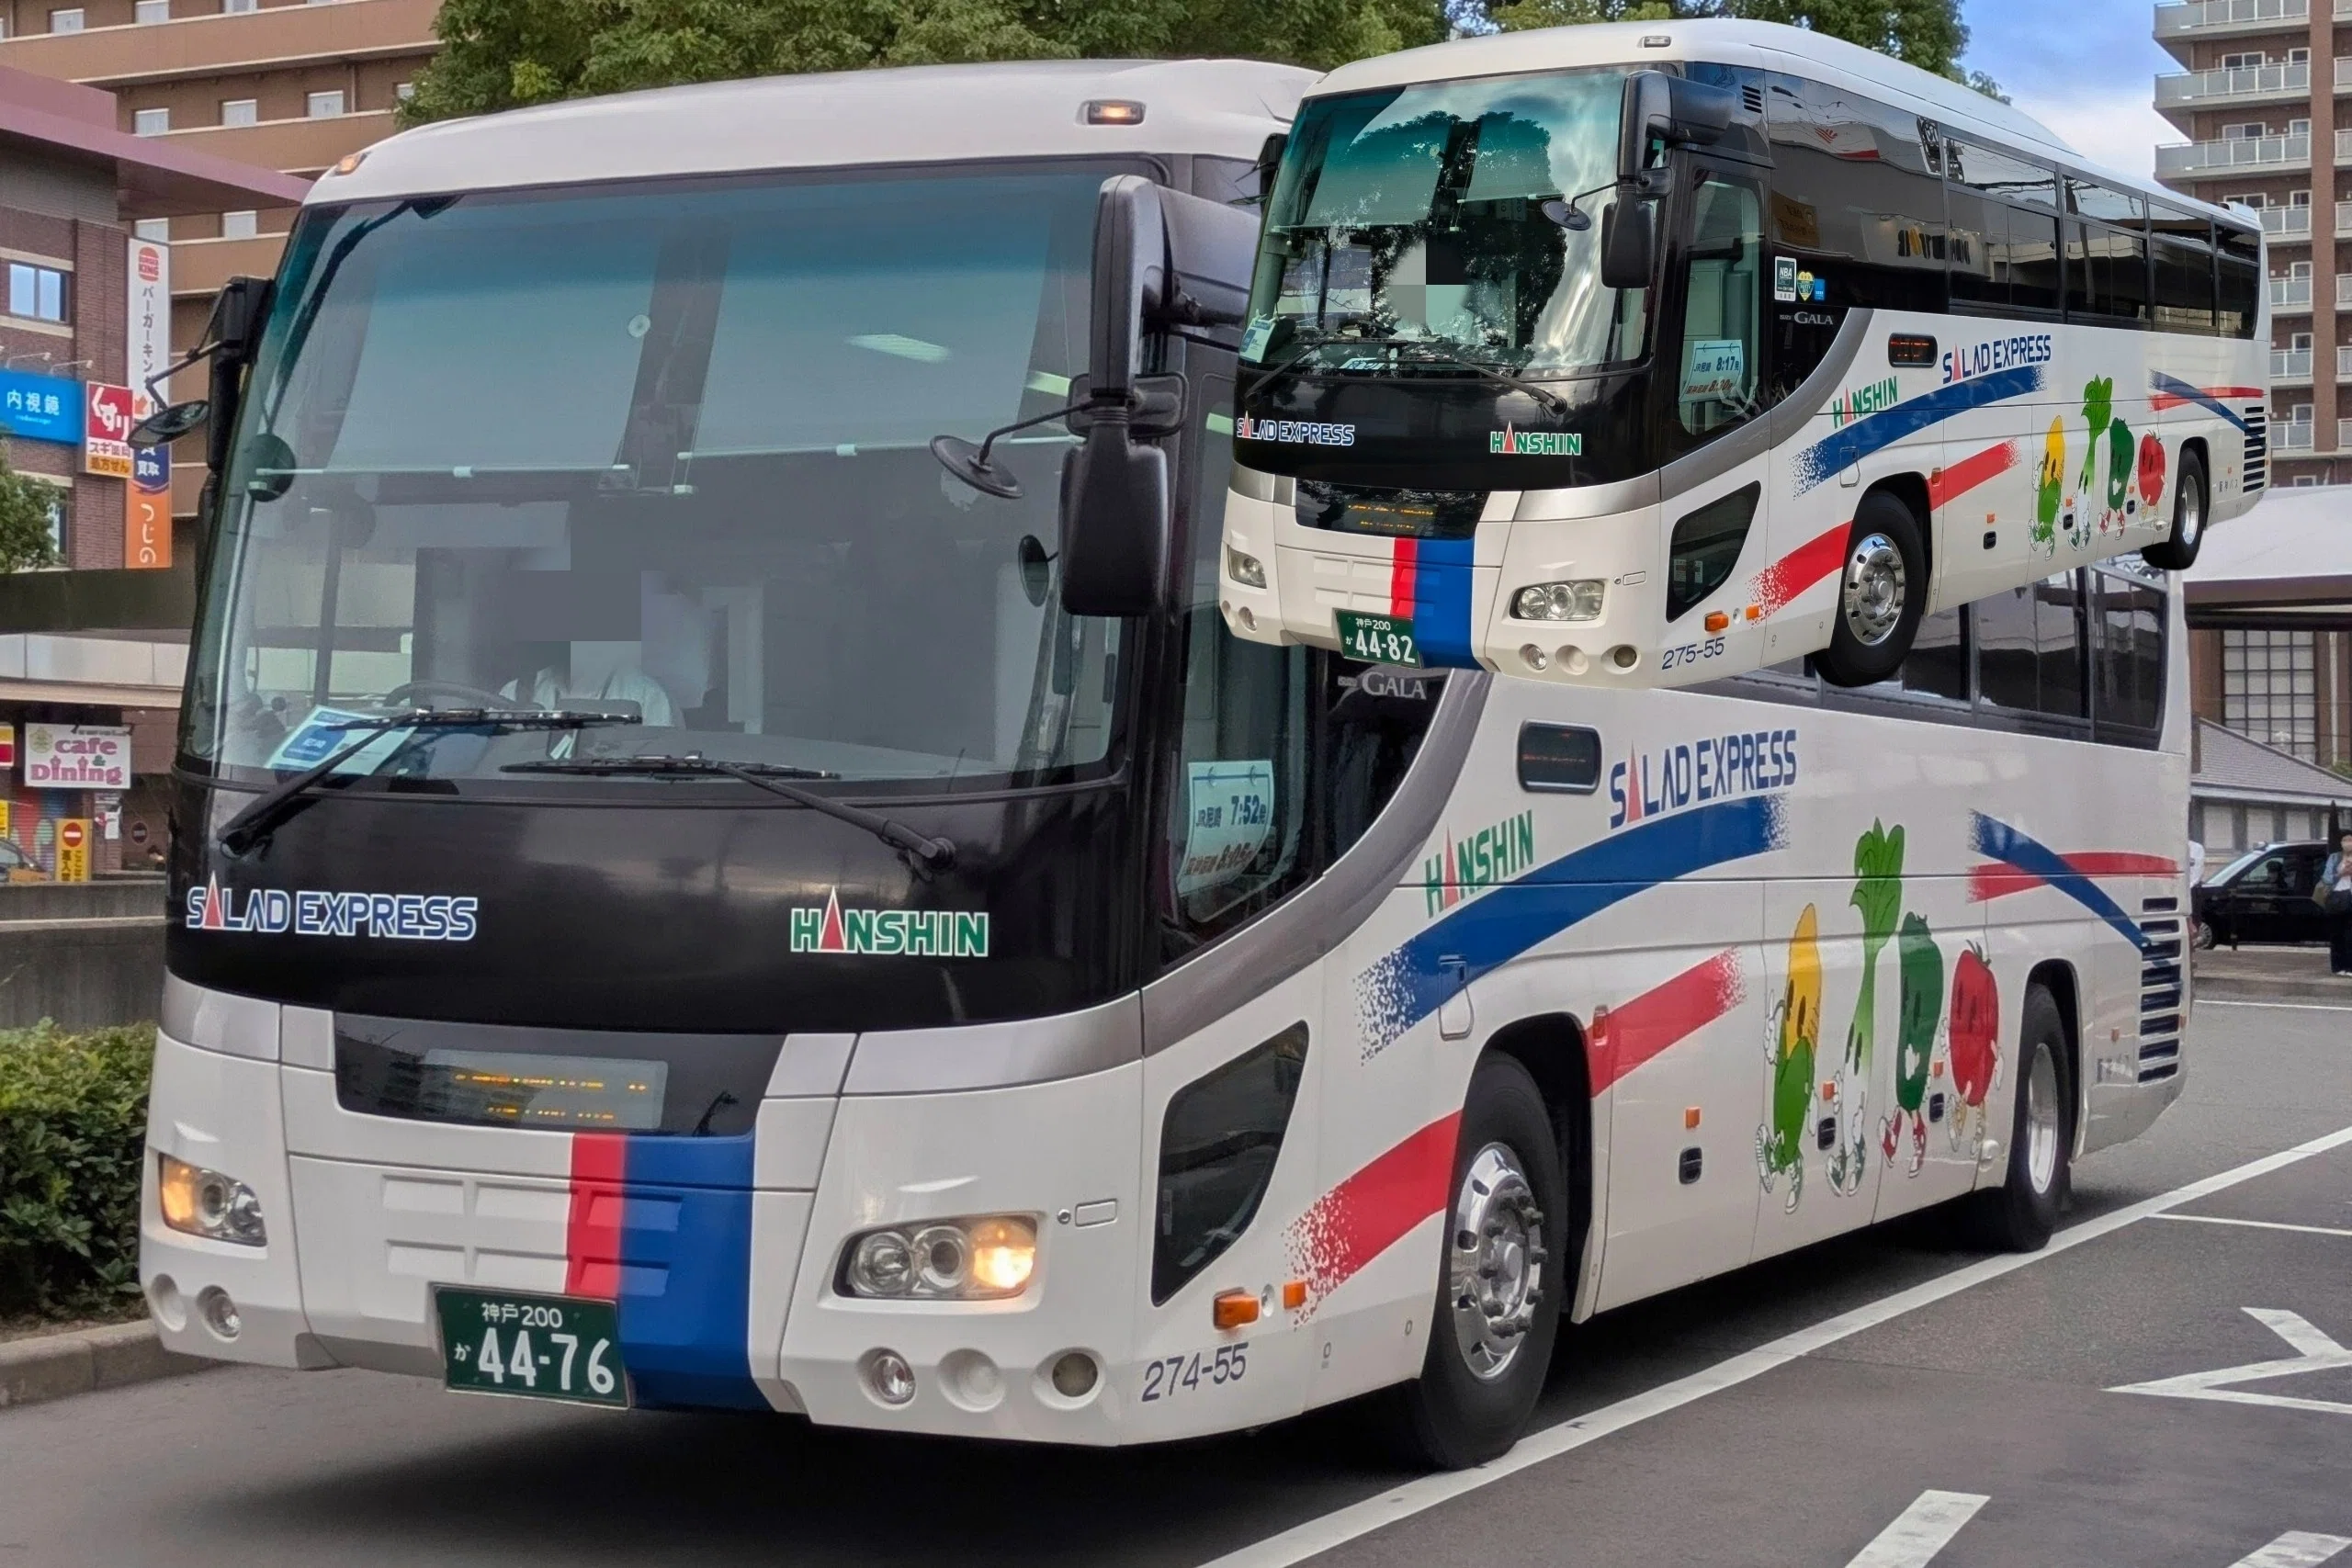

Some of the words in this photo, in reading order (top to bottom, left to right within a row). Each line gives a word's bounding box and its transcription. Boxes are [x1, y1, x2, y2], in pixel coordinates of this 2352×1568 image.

[139, 264, 159, 276] KING
[1779, 266, 1792, 277] NBA
[1793, 311, 1834, 325] GALA
[1942, 343, 1990, 384] SALAD
[1993, 334, 2052, 368] EXPRESS
[7, 389, 60, 415] 内視鏡
[1832, 375, 1898, 429] HANSHIN
[1237, 410, 1277, 441] SALAD
[1278, 421, 1355, 446] EXPRESS
[1489, 420, 1582, 456] HANSHIN
[1345, 636, 1353, 645] か
[1355, 629, 1416, 663] 44-82
[1661, 636, 1725, 670] 275-55
[1362, 671, 1427, 700] GALA
[55, 738, 118, 755] cafe
[30, 755, 122, 785] Dining
[1610, 739, 1690, 829] SALAD
[1696, 729, 1798, 802] EXPRESS
[1425, 808, 1534, 919] HANSHIN
[187, 870, 290, 932] SALAD
[295, 890, 478, 941] EXPRESS
[790, 885, 989, 957] HANSHIN
[481, 1302, 563, 1328] 神戸200
[454, 1342, 471, 1361] か
[478, 1326, 615, 1394] 44-76
[1141, 1342, 1250, 1403] 274-55
